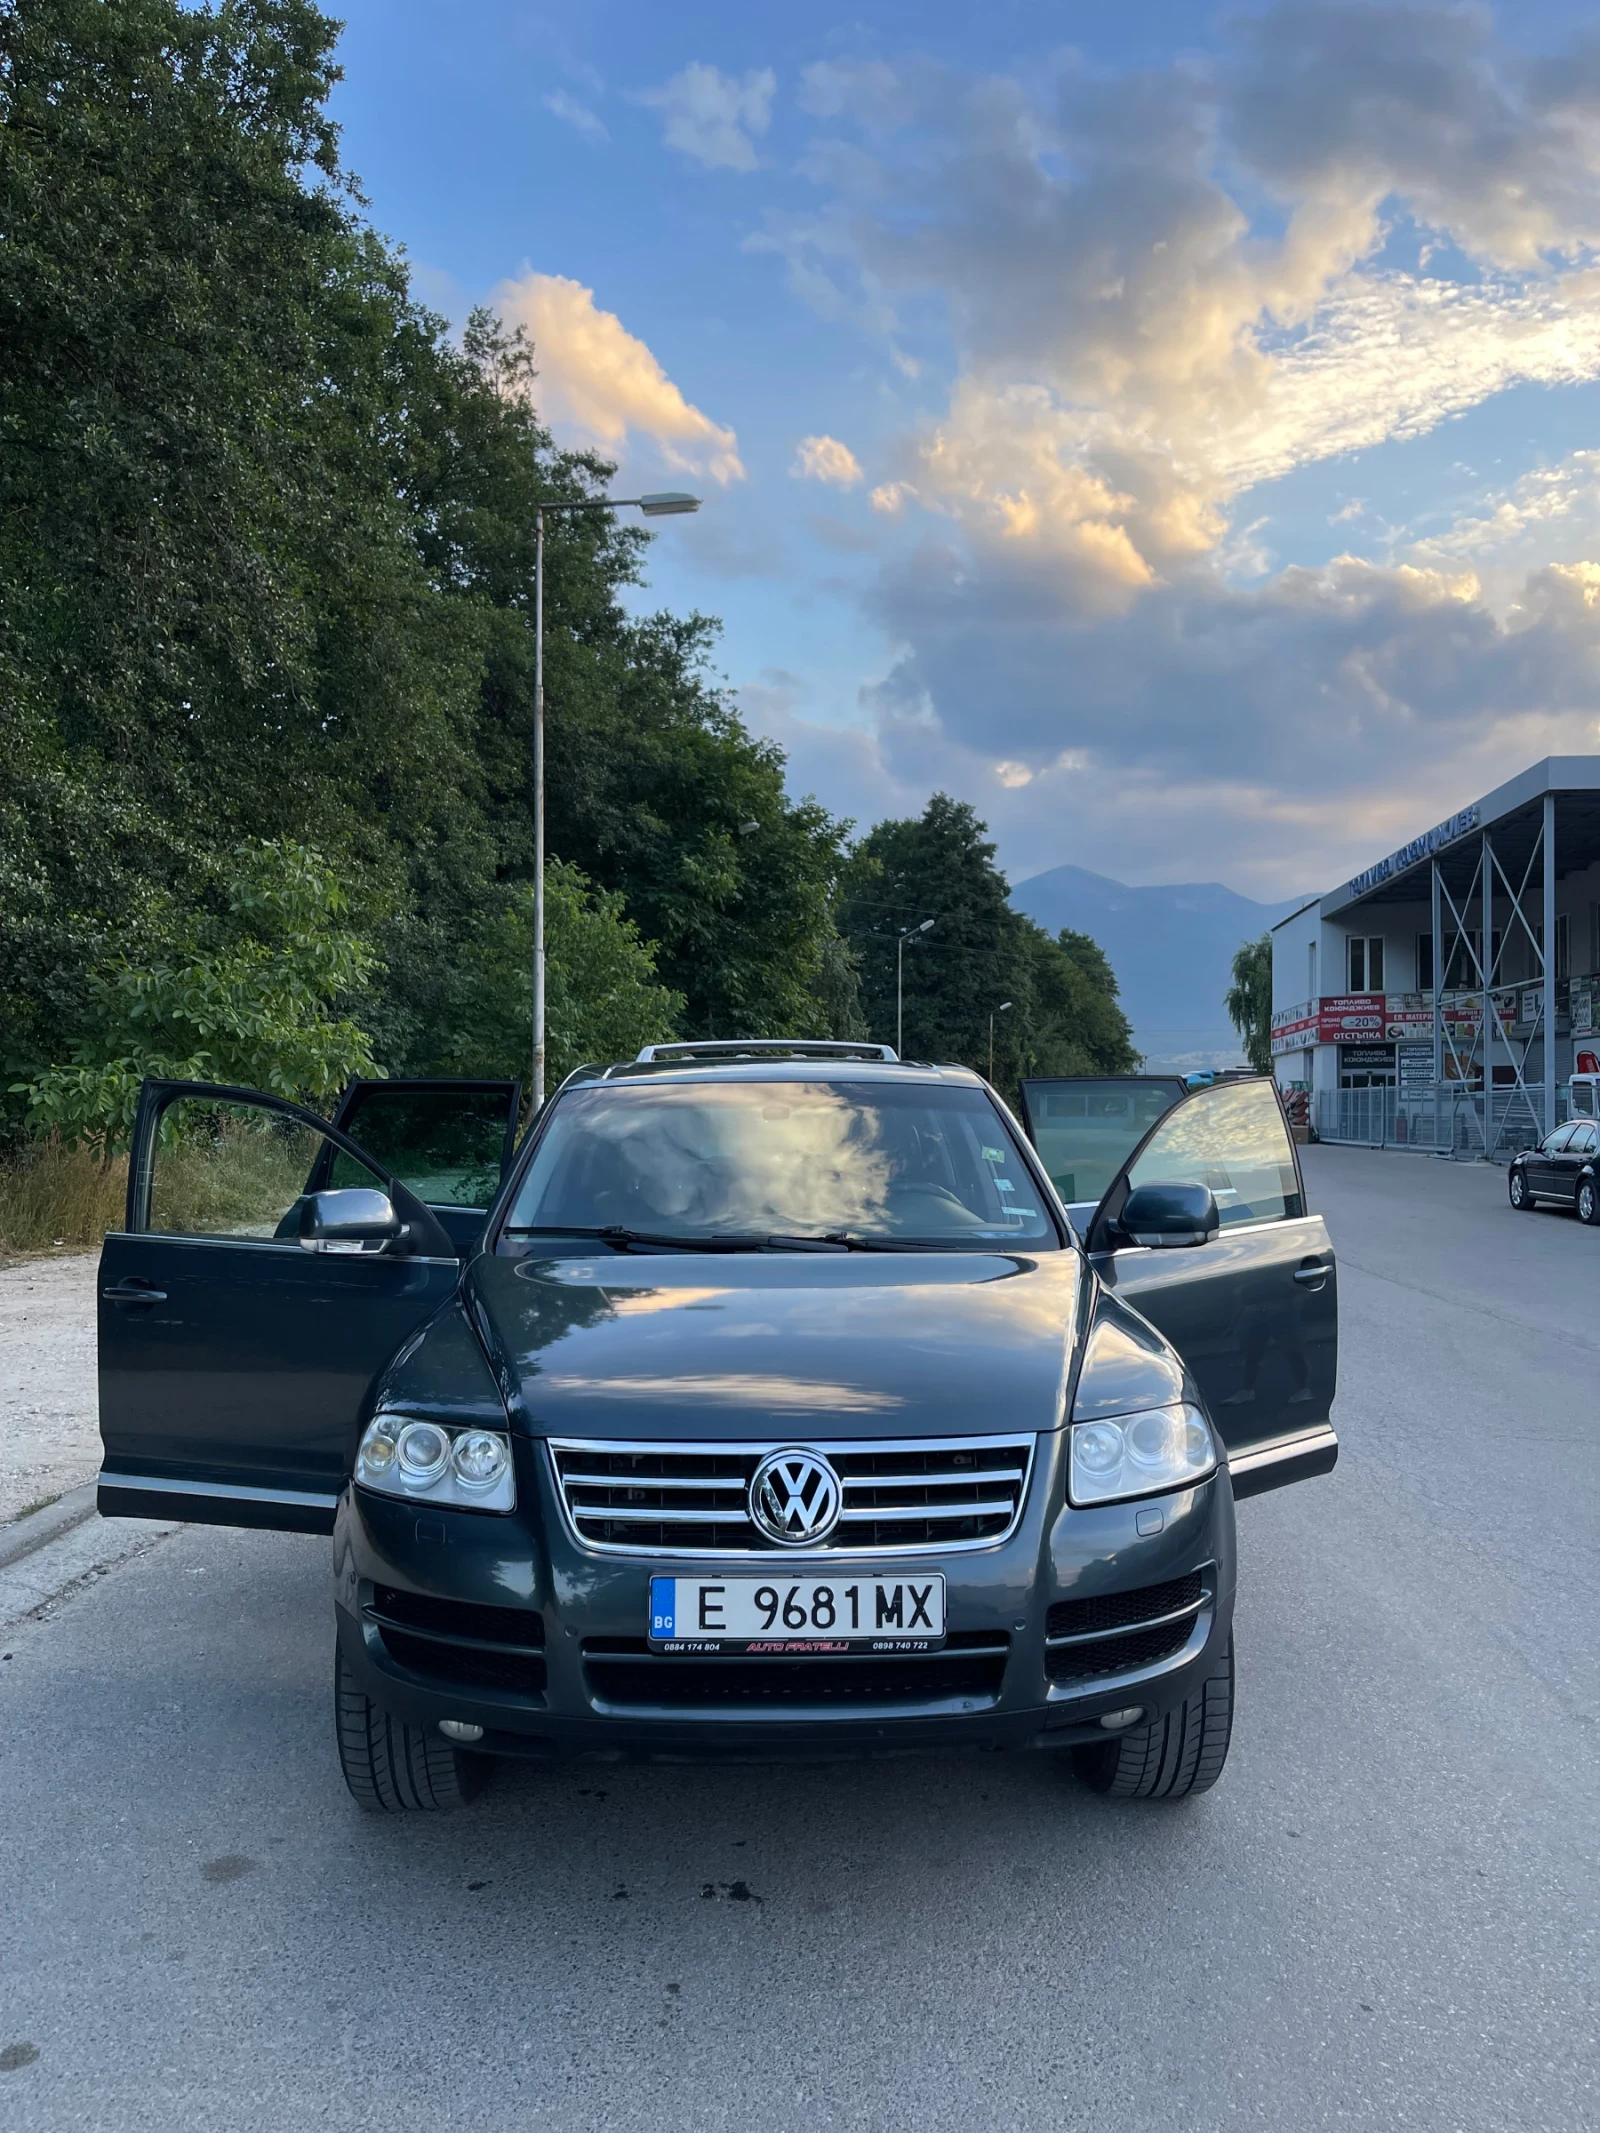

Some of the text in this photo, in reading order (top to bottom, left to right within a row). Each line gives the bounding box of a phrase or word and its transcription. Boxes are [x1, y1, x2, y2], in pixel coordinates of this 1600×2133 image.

[699, 1584, 933, 1630] E 9681 MX
[654, 1616, 673, 1629] BG
[664, 1643, 720, 1651] 0884 174 804
[746, 1642, 849, 1652] AUTO FRATELLI
[873, 1641, 928, 1650] 0898 740 722
